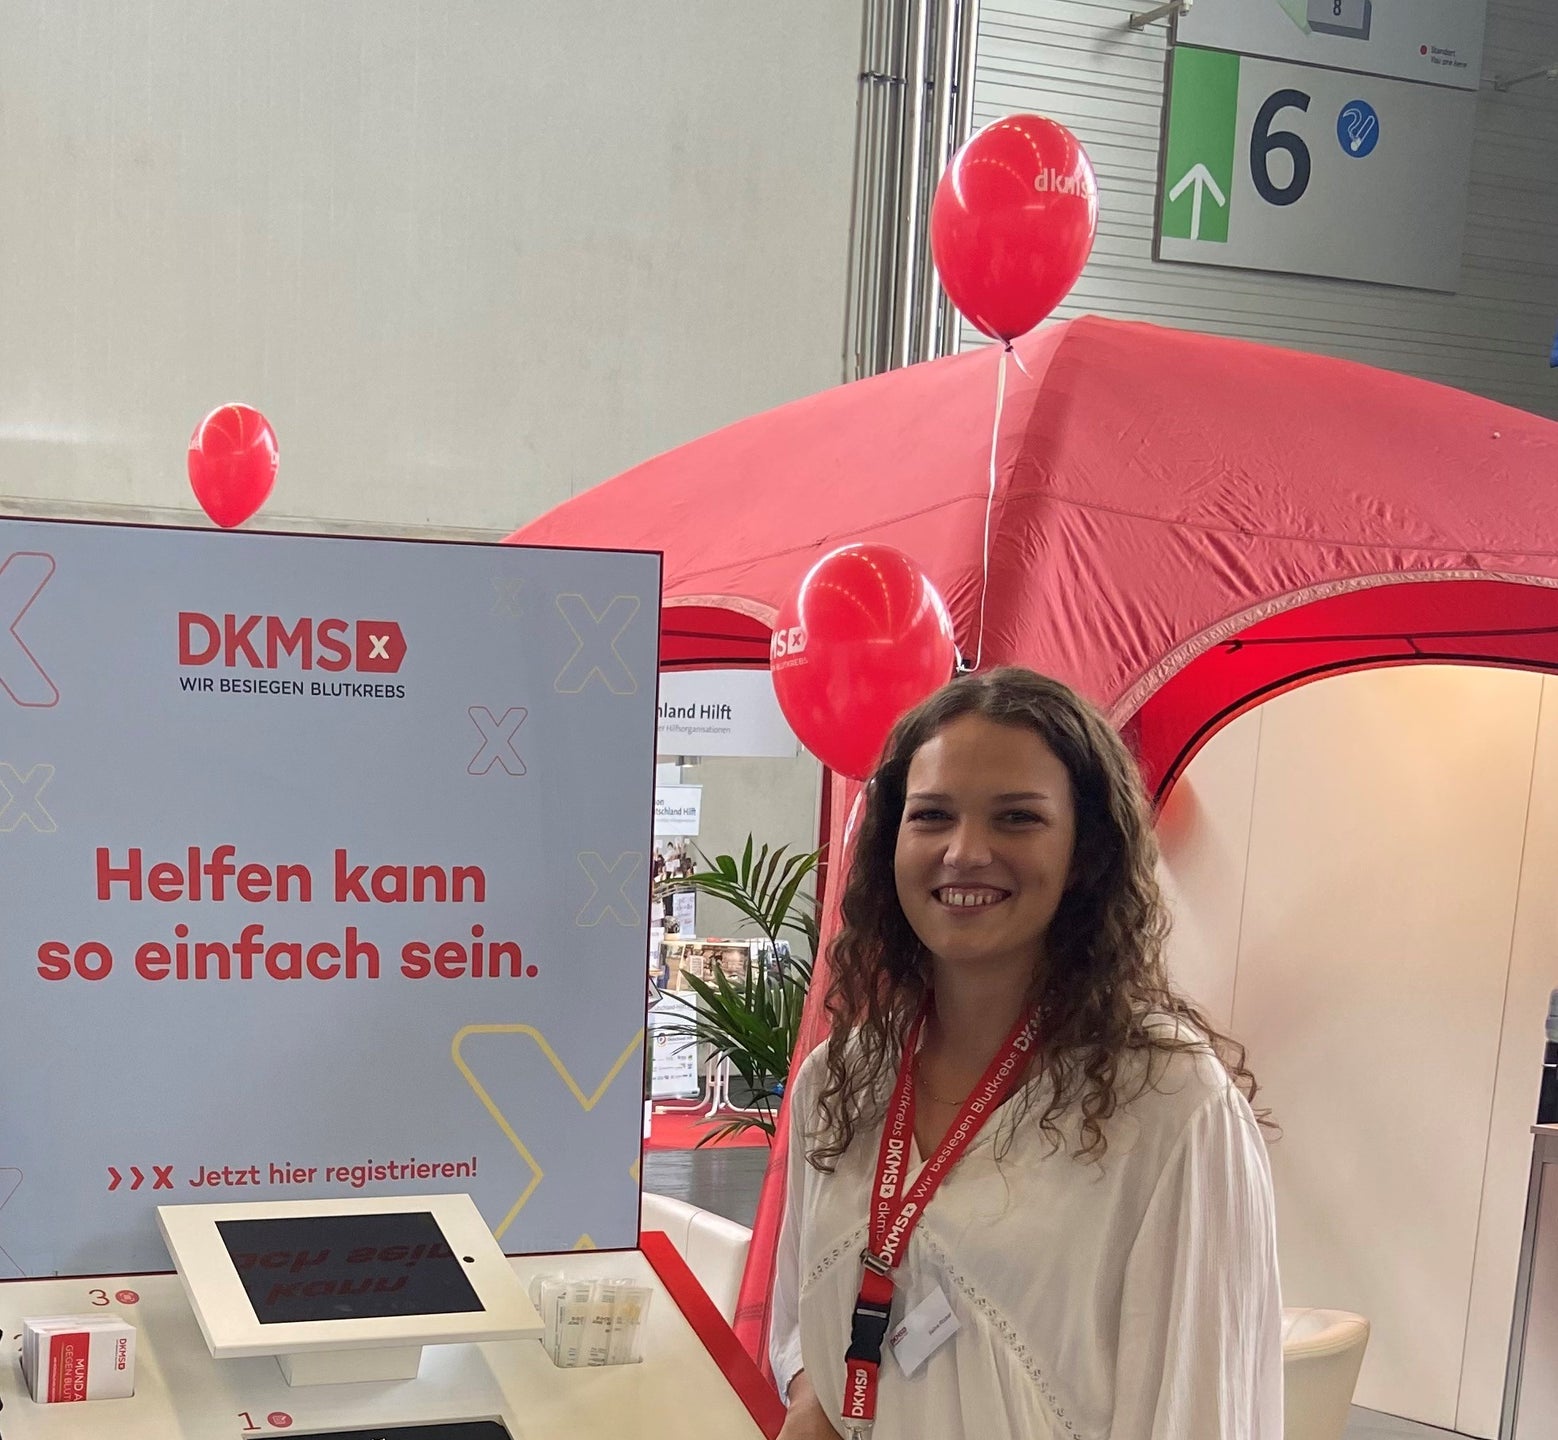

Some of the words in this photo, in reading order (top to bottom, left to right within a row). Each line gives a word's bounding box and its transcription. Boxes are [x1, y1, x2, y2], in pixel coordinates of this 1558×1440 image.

[1250, 89, 1311, 206] 6
[178, 611, 352, 673] DKMS
[179, 676, 214, 692] WIR
[220, 678, 304, 696] BESIEGEN
[310, 682, 406, 699] BLUTKREBS
[700, 704, 732, 720] Hilft
[95, 845, 312, 902] Helfen
[333, 848, 486, 903] kann
[37, 941, 113, 981] so
[135, 923, 380, 981] einfach
[400, 923, 539, 979] sein.
[913, 1175, 933, 1199] Wir
[929, 1114, 976, 1173] besiegen
[970, 1051, 1019, 1114] Blutkrebs
[189, 1165, 261, 1188] Jetzt
[268, 1161, 318, 1185] hier
[325, 1156, 478, 1189] registrieren!
[882, 1138, 904, 1185] DKMS
[89, 1289, 110, 1306] 3
[64, 1344, 74, 1375] GEGEN
[74, 1358, 85, 1391] MUND
[851, 1376, 868, 1417] DKMS
[238, 1411, 262, 1431] 1
